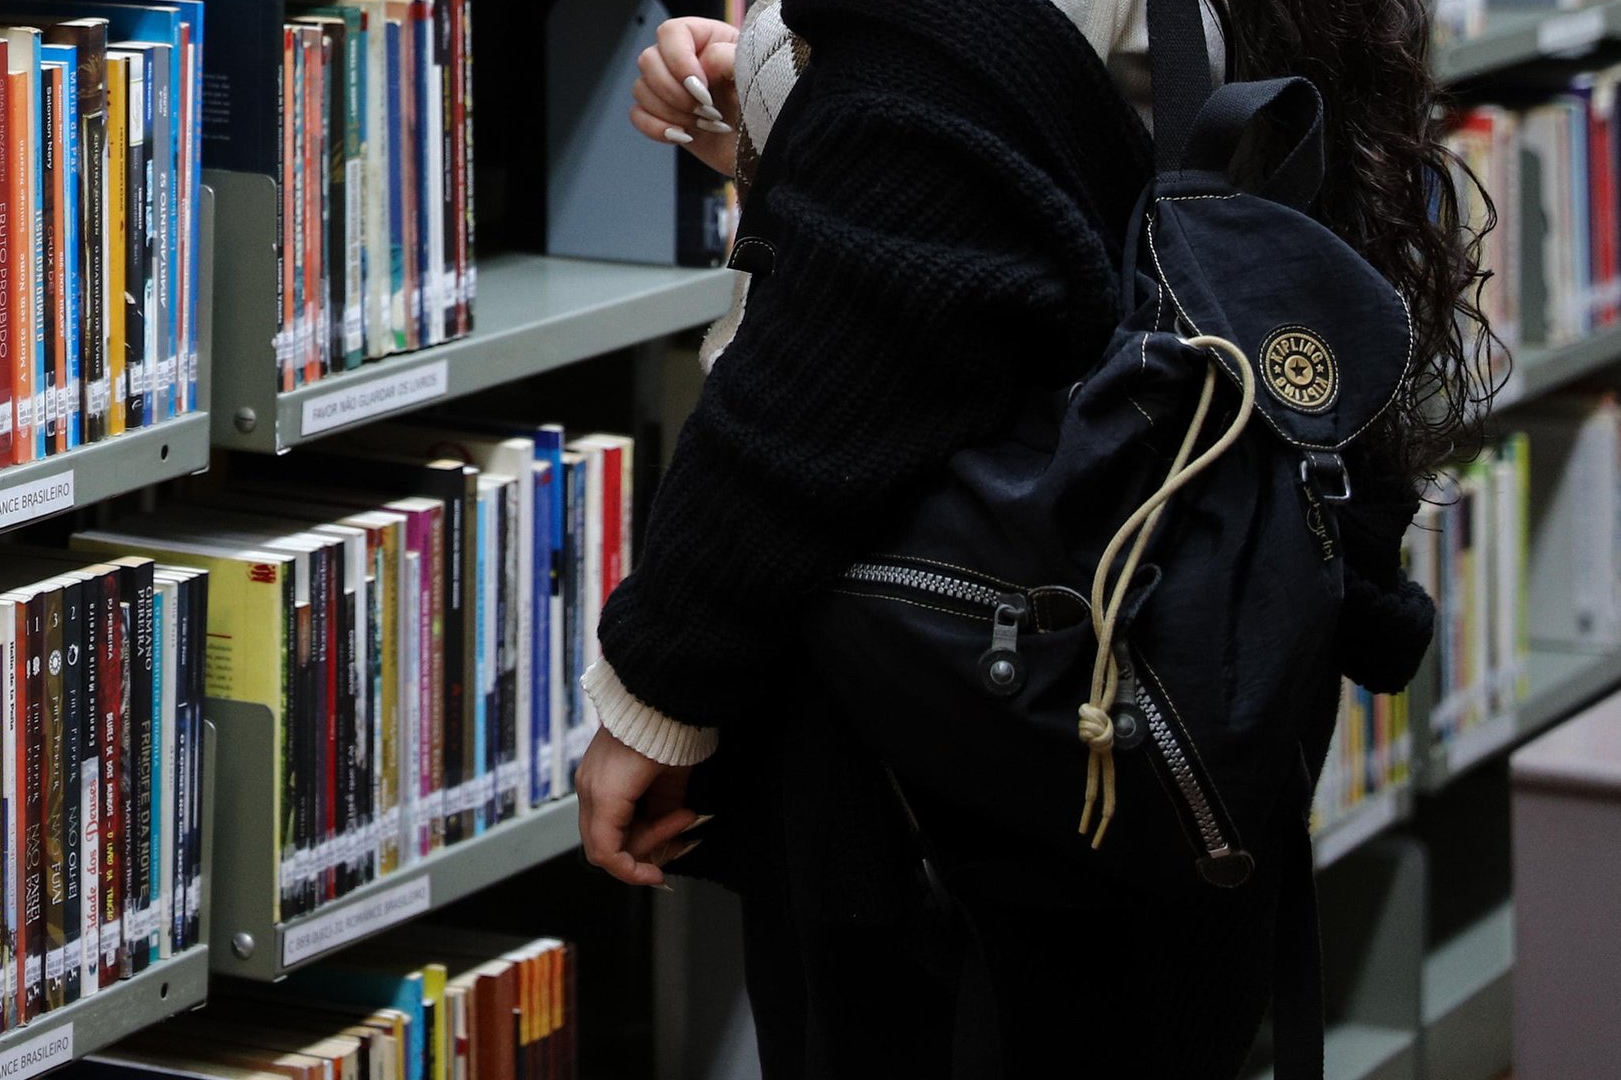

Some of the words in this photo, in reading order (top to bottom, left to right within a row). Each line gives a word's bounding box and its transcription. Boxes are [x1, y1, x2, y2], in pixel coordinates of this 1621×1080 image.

[45, 86, 53, 138] Salomon
[44, 139, 53, 170] Nery
[1271, 338, 1323, 363] KIPLING
[1276, 377, 1328, 401] KIPLING
[22, 483, 70, 508] BRASILEIRO
[137, 589, 145, 658] PEREIRA
[144, 586, 152, 671] GERMANO
[140, 810, 150, 839] DA
[140, 844, 150, 897] NOITE
[21, 1037, 68, 1069] BRASILEIRO
